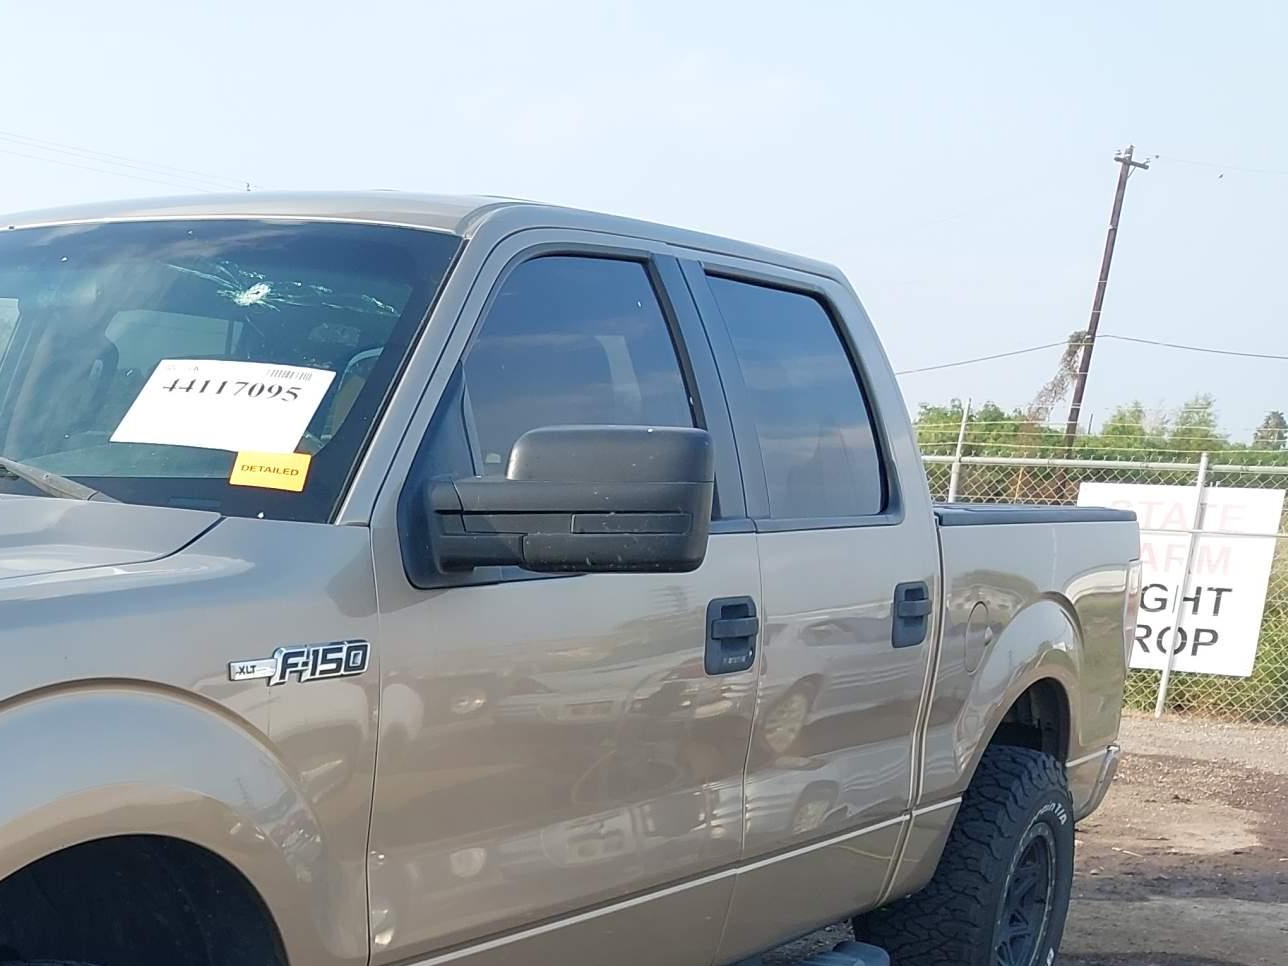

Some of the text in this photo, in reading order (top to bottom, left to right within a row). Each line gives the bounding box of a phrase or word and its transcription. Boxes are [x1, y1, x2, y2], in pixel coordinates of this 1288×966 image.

[162, 378, 303, 402] 44117095
[240, 464, 299, 477] DETAILED
[1111, 500, 1248, 532] TAE
[238, 642, 370, 686] XLT F-150
